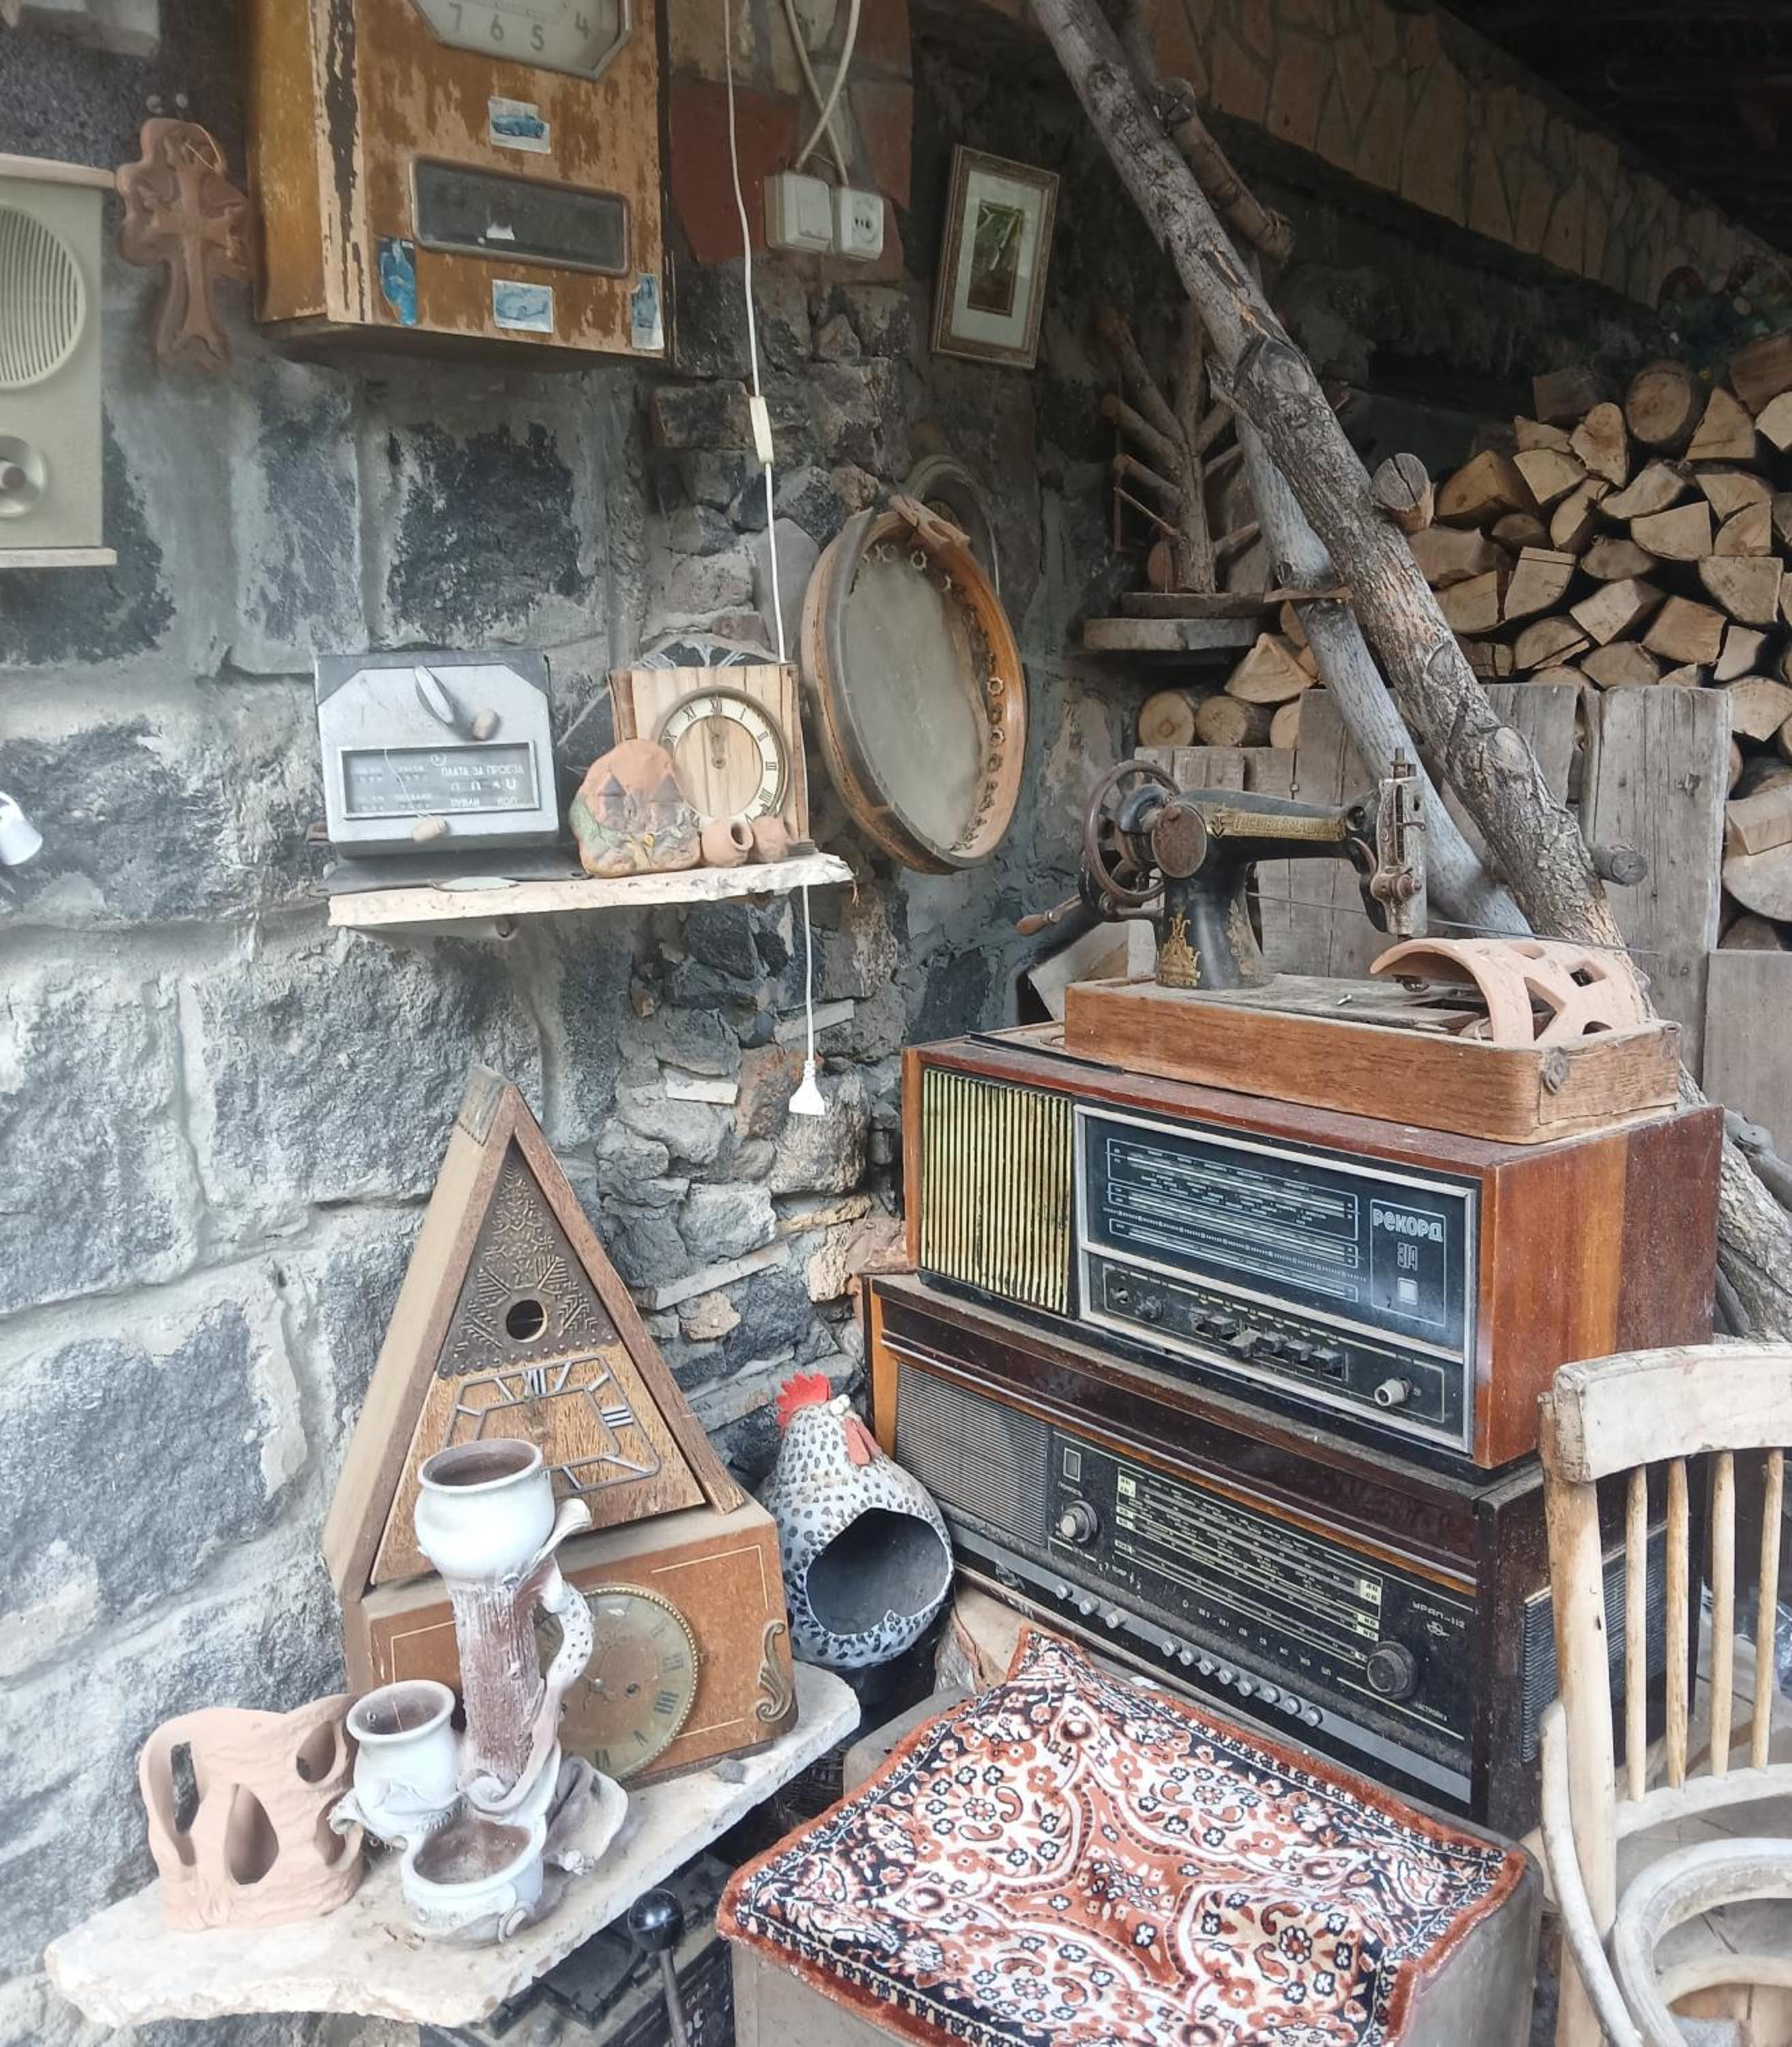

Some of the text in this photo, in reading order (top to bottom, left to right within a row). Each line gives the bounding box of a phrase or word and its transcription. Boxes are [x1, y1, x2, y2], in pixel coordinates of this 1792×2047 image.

[491, 14, 504, 42] 6
[530, 24, 545, 51] 5
[575, 11, 590, 39] 4
[765, 761, 777, 772] III
[1397, 1242, 1418, 1272] 314
